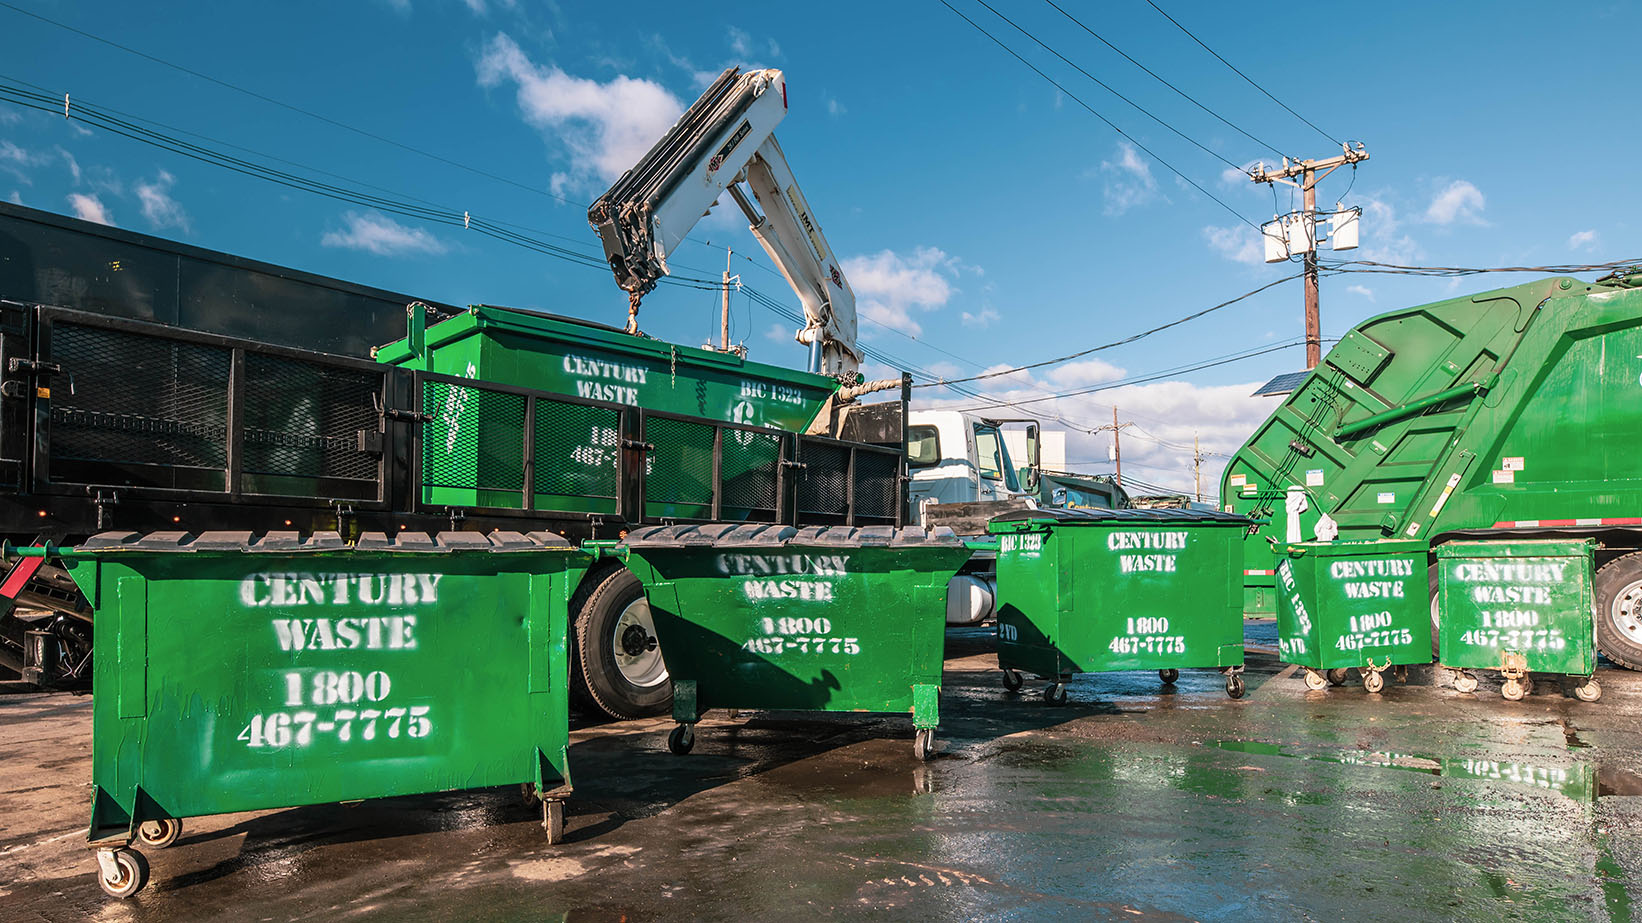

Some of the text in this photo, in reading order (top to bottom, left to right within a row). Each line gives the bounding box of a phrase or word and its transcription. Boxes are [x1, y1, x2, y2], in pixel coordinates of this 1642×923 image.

[801, 212, 815, 233] IMT
[563, 354, 648, 384] CENTURY
[576, 380, 639, 407] WASTE
[741, 380, 767, 399] BIC
[1001, 534, 1041, 553] BIC 1323
[1107, 531, 1188, 550] CENTURY
[717, 554, 850, 576] CENTURY
[1119, 554, 1176, 573] WASTE
[1330, 559, 1414, 579] CENTURY
[1454, 561, 1569, 582] CENTURY
[240, 573, 443, 607] CENTURY
[744, 580, 834, 600] WASTE
[1344, 580, 1405, 599] WASTE
[1473, 586, 1553, 605] WASTE
[272, 615, 417, 651] WASTE
[1335, 628, 1413, 651] 467-7775
[1460, 629, 1567, 650] 467-7775
[741, 637, 861, 655] 467-7775
[1108, 636, 1186, 654] 467-7775
[237, 706, 432, 747] 467-7775
